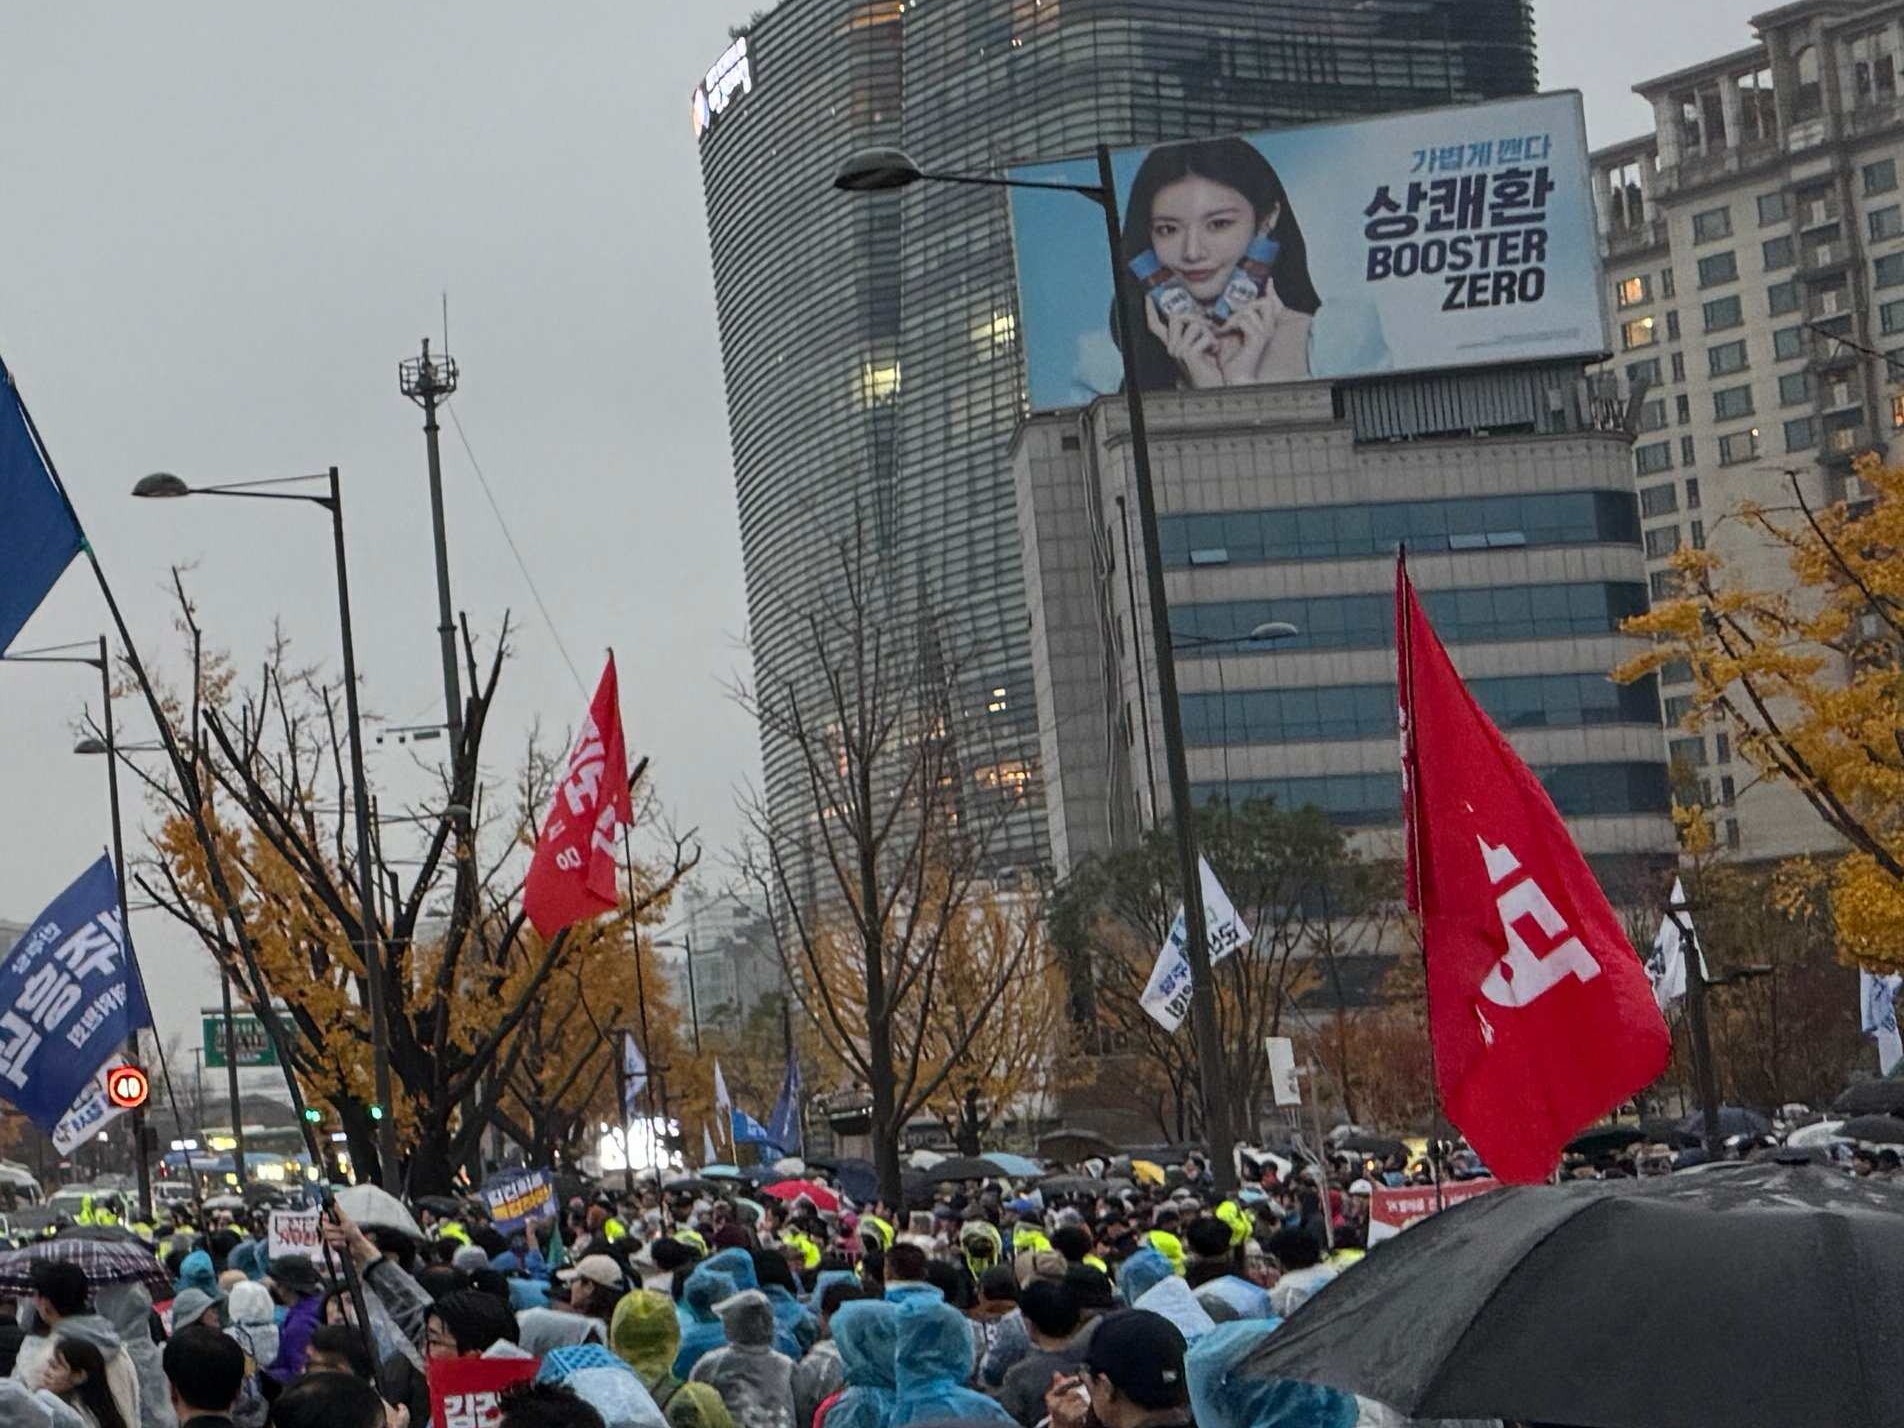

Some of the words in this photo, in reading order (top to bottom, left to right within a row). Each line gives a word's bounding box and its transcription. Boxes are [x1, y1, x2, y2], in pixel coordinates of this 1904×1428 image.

[1410, 141, 1493, 173] 가볍게
[1496, 134, 1553, 165] 깬다
[1363, 166, 1556, 242] 상쾌환
[1366, 228, 1549, 281] BOOSTER
[1442, 267, 1546, 312] ZERO
